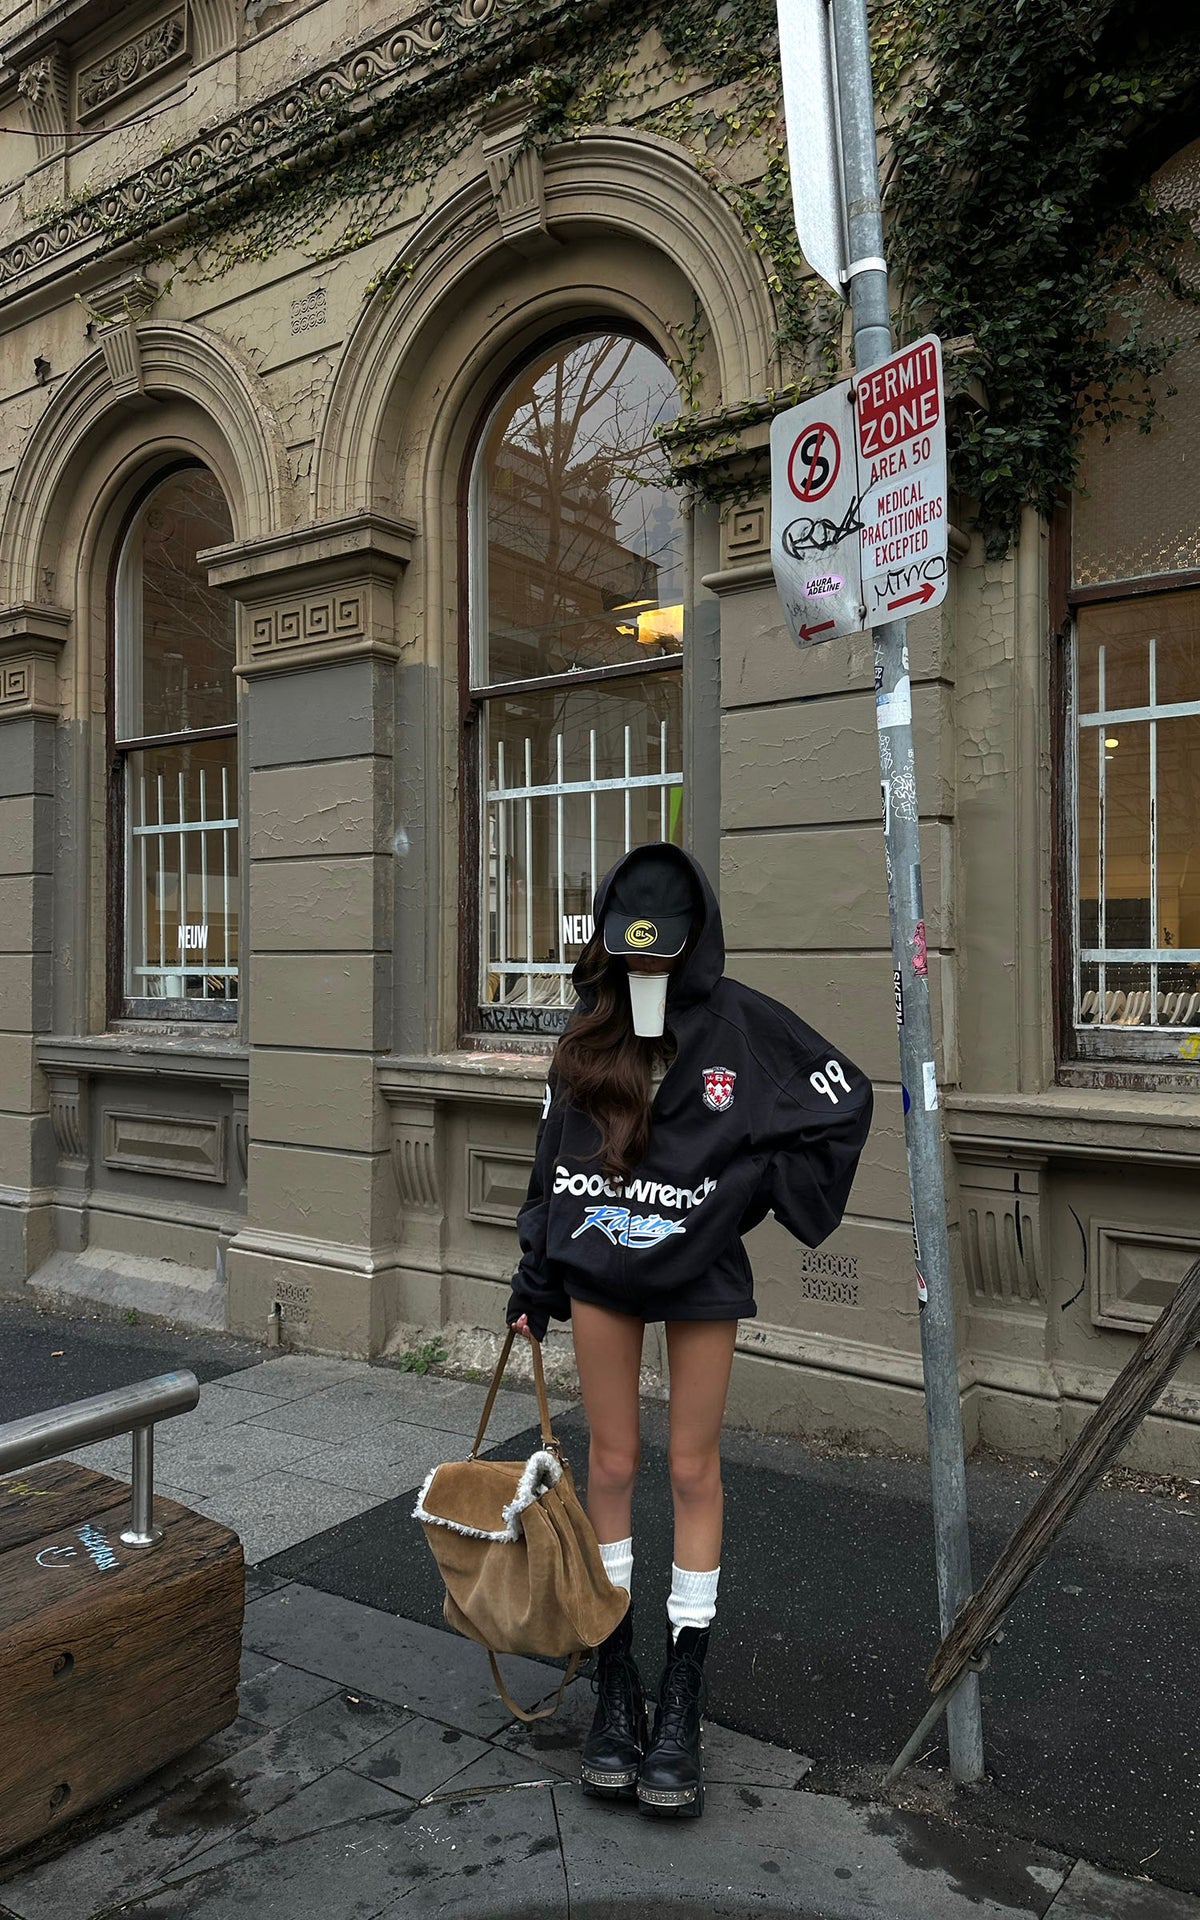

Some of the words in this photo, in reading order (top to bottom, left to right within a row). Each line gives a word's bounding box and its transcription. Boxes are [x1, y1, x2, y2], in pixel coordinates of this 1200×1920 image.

[858, 345, 933, 415] PERMIT
[861, 388, 938, 455] ZONE
[870, 449, 907, 484] AREA
[912, 437, 931, 465] 50
[877, 480, 924, 518] MEDICAL
[861, 497, 943, 549] PRACTITIONERS
[875, 529, 928, 568] EXCEPTED
[806, 577, 832, 589] LAURA
[807, 582, 841, 596] ADELINE
[178, 925, 208, 949] NEUW
[562, 915, 595, 944] NEU
[810, 1060, 852, 1105] 99
[571, 1205, 687, 1249] Racing
